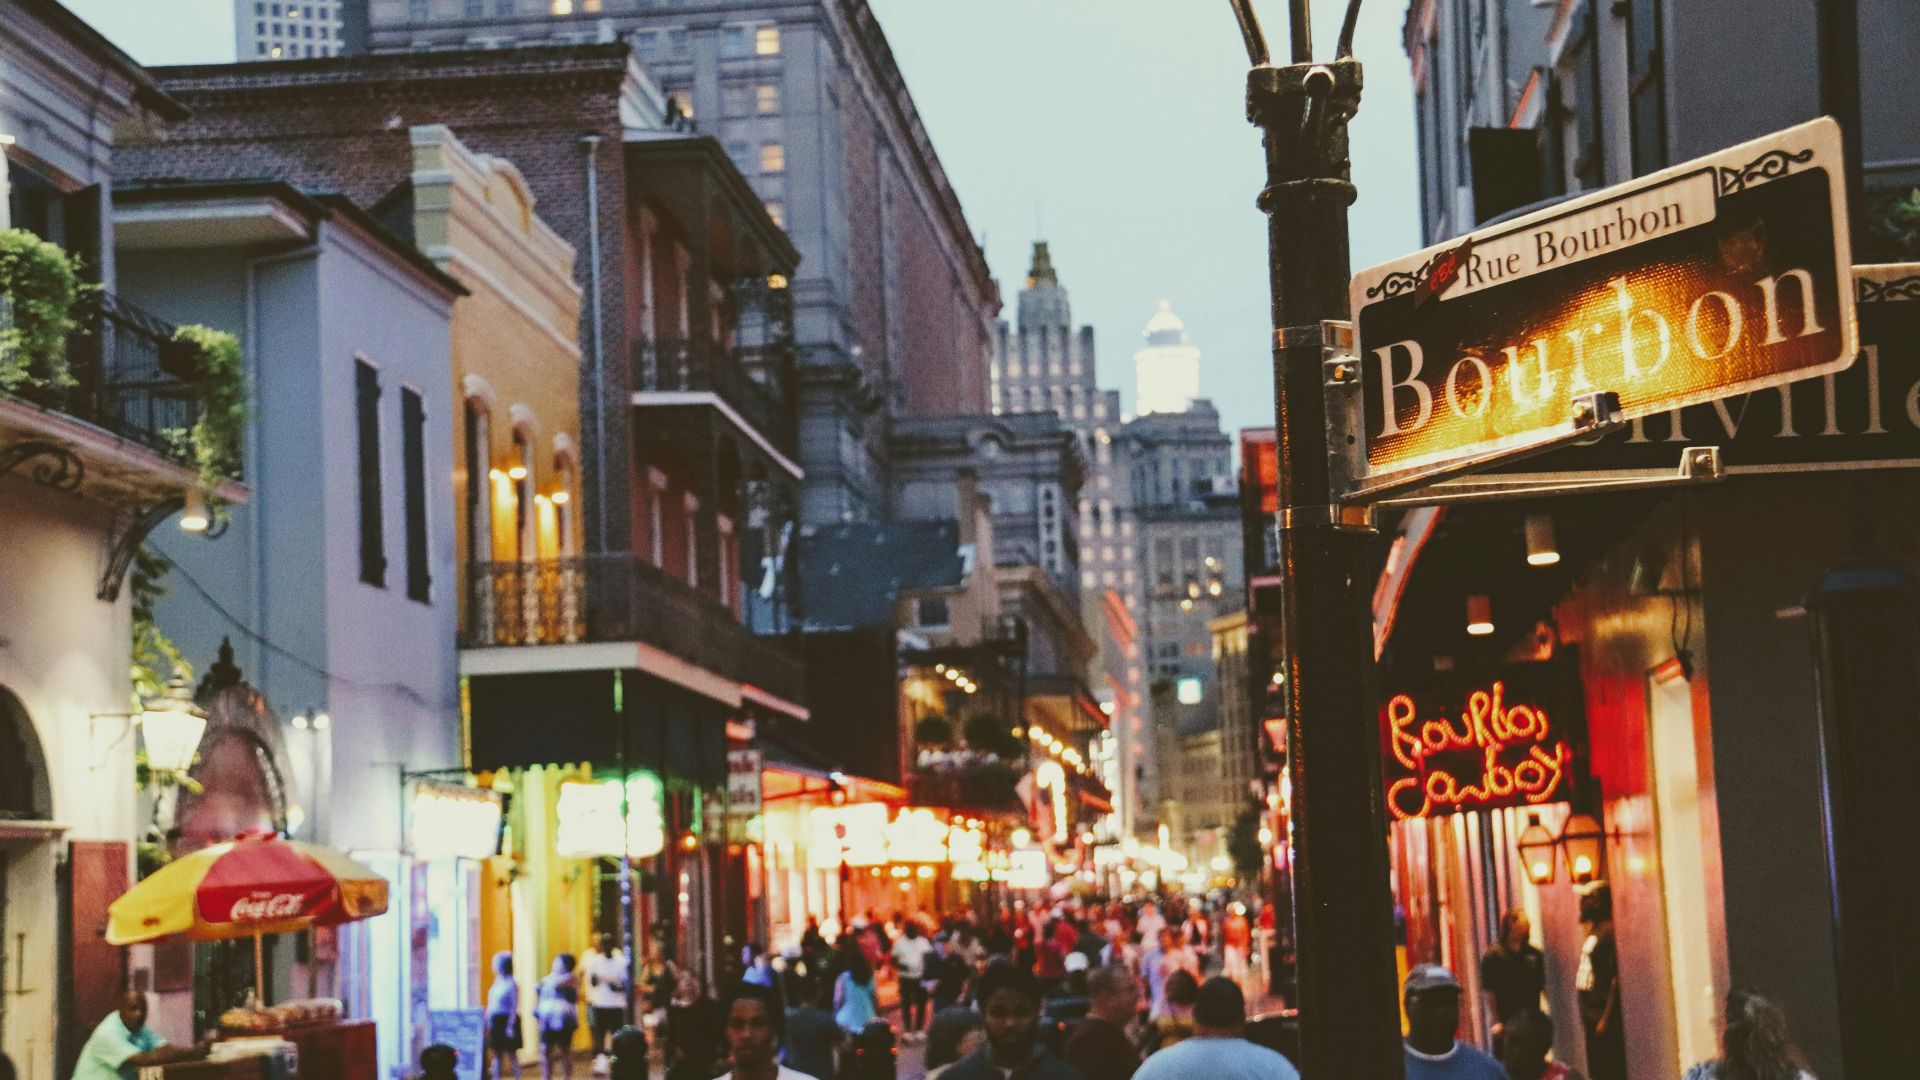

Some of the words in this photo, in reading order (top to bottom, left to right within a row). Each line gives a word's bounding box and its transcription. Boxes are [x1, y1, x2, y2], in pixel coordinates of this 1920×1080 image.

[1465, 253, 1521, 288] Rue
[1534, 202, 1684, 267] Bourbon
[1371, 268, 1825, 440] Bourbon
